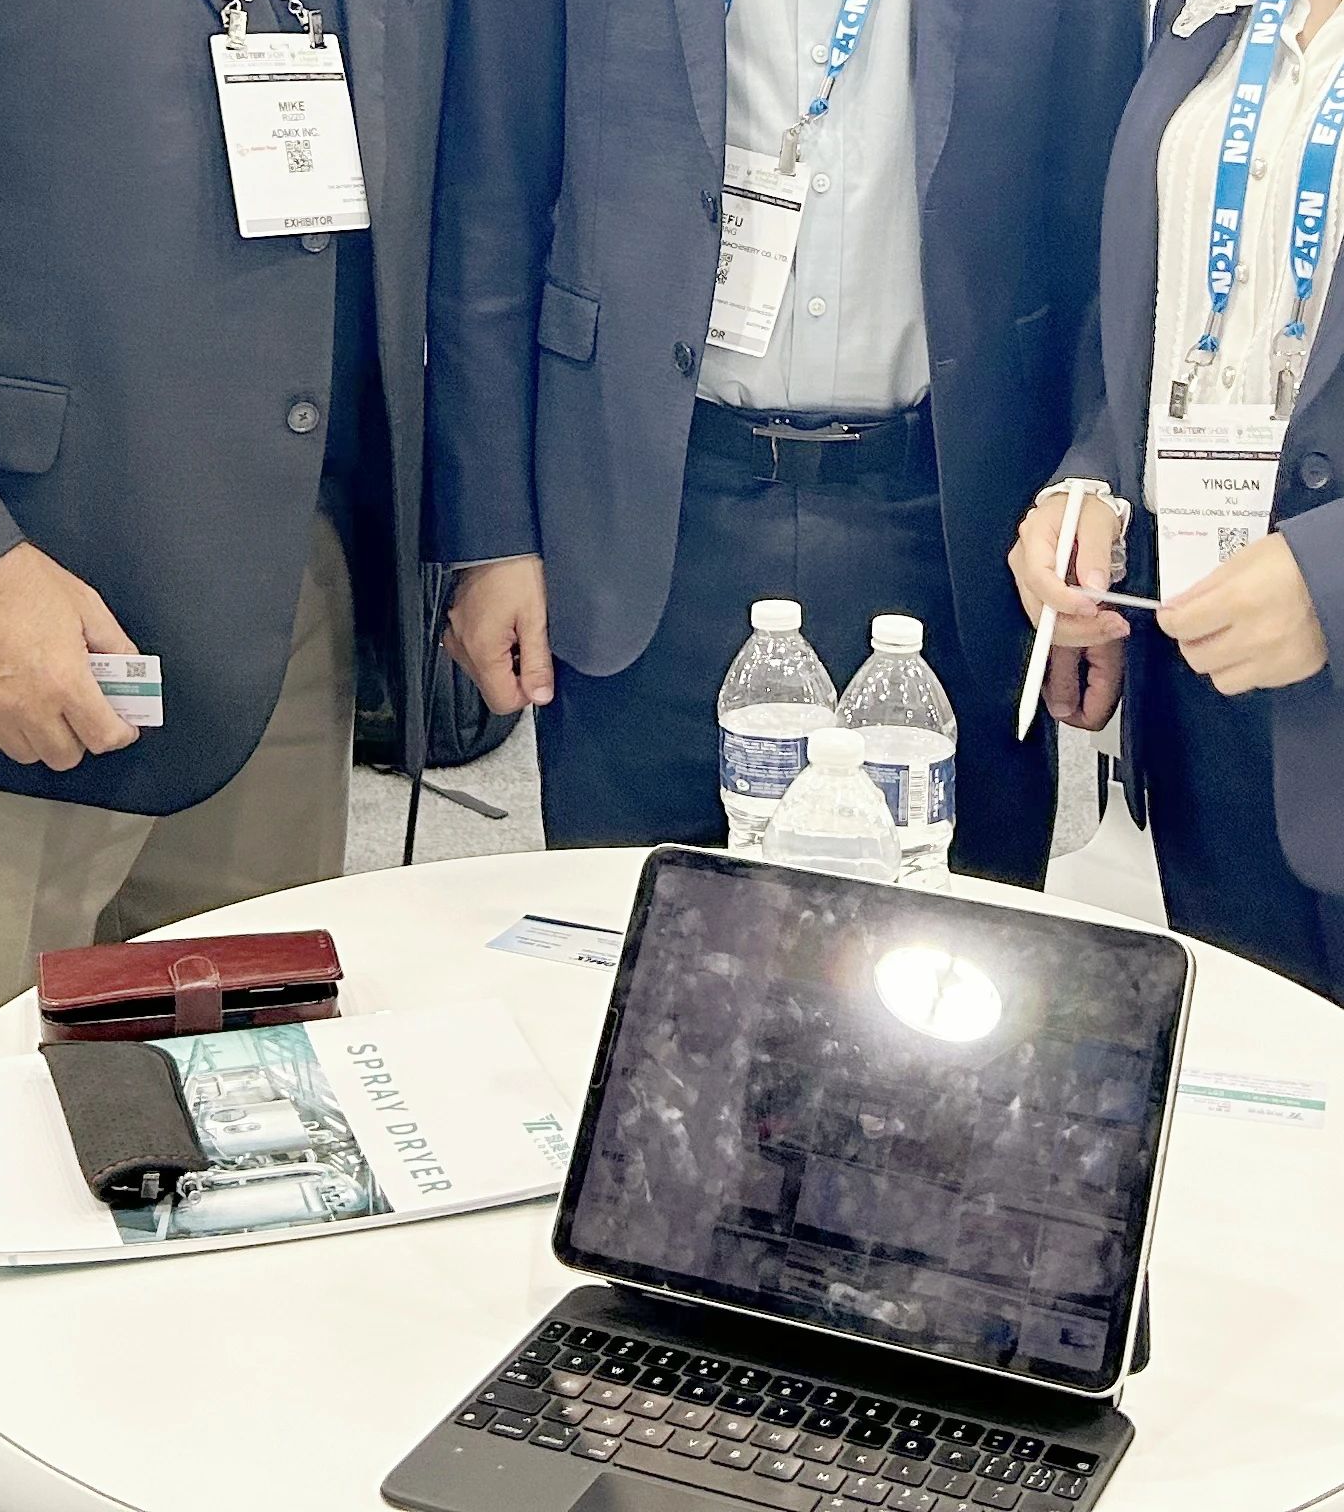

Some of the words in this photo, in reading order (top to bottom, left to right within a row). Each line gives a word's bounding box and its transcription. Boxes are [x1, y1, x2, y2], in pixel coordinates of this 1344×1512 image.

[278, 101, 306, 112] MIKE
[1222, 83, 1263, 165] EATON
[284, 216, 334, 228] EXHIBITOR
[1209, 208, 1239, 295] EATON
[1289, 190, 1325, 281] EATON
[1201, 478, 1261, 491] YINGLAN
[346, 1043, 409, 1112] SPRAY
[386, 1121, 453, 1195] DRYER
